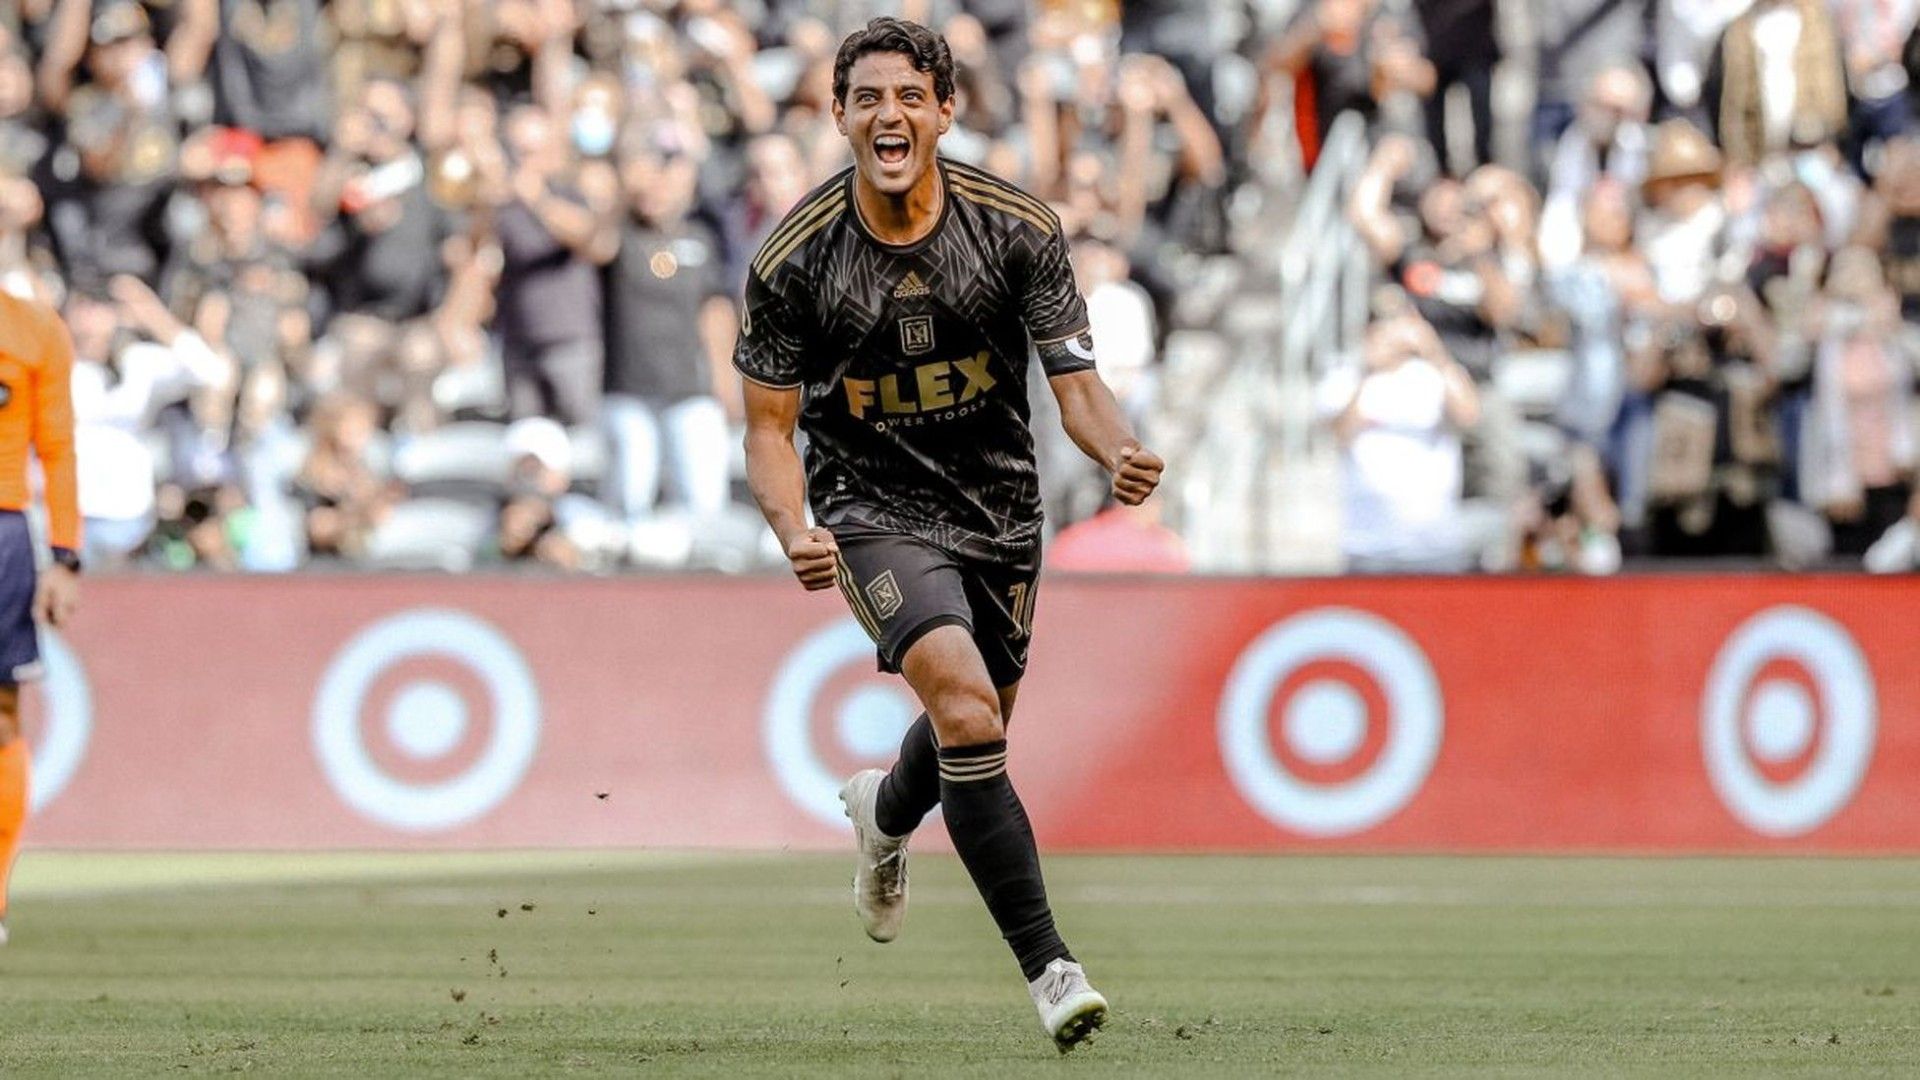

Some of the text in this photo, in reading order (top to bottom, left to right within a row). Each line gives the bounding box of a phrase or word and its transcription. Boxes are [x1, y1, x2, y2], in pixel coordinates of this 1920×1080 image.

[893, 285, 931, 299] adidas
[843, 351, 996, 420] FLEX
[874, 416, 925, 433] OWER
